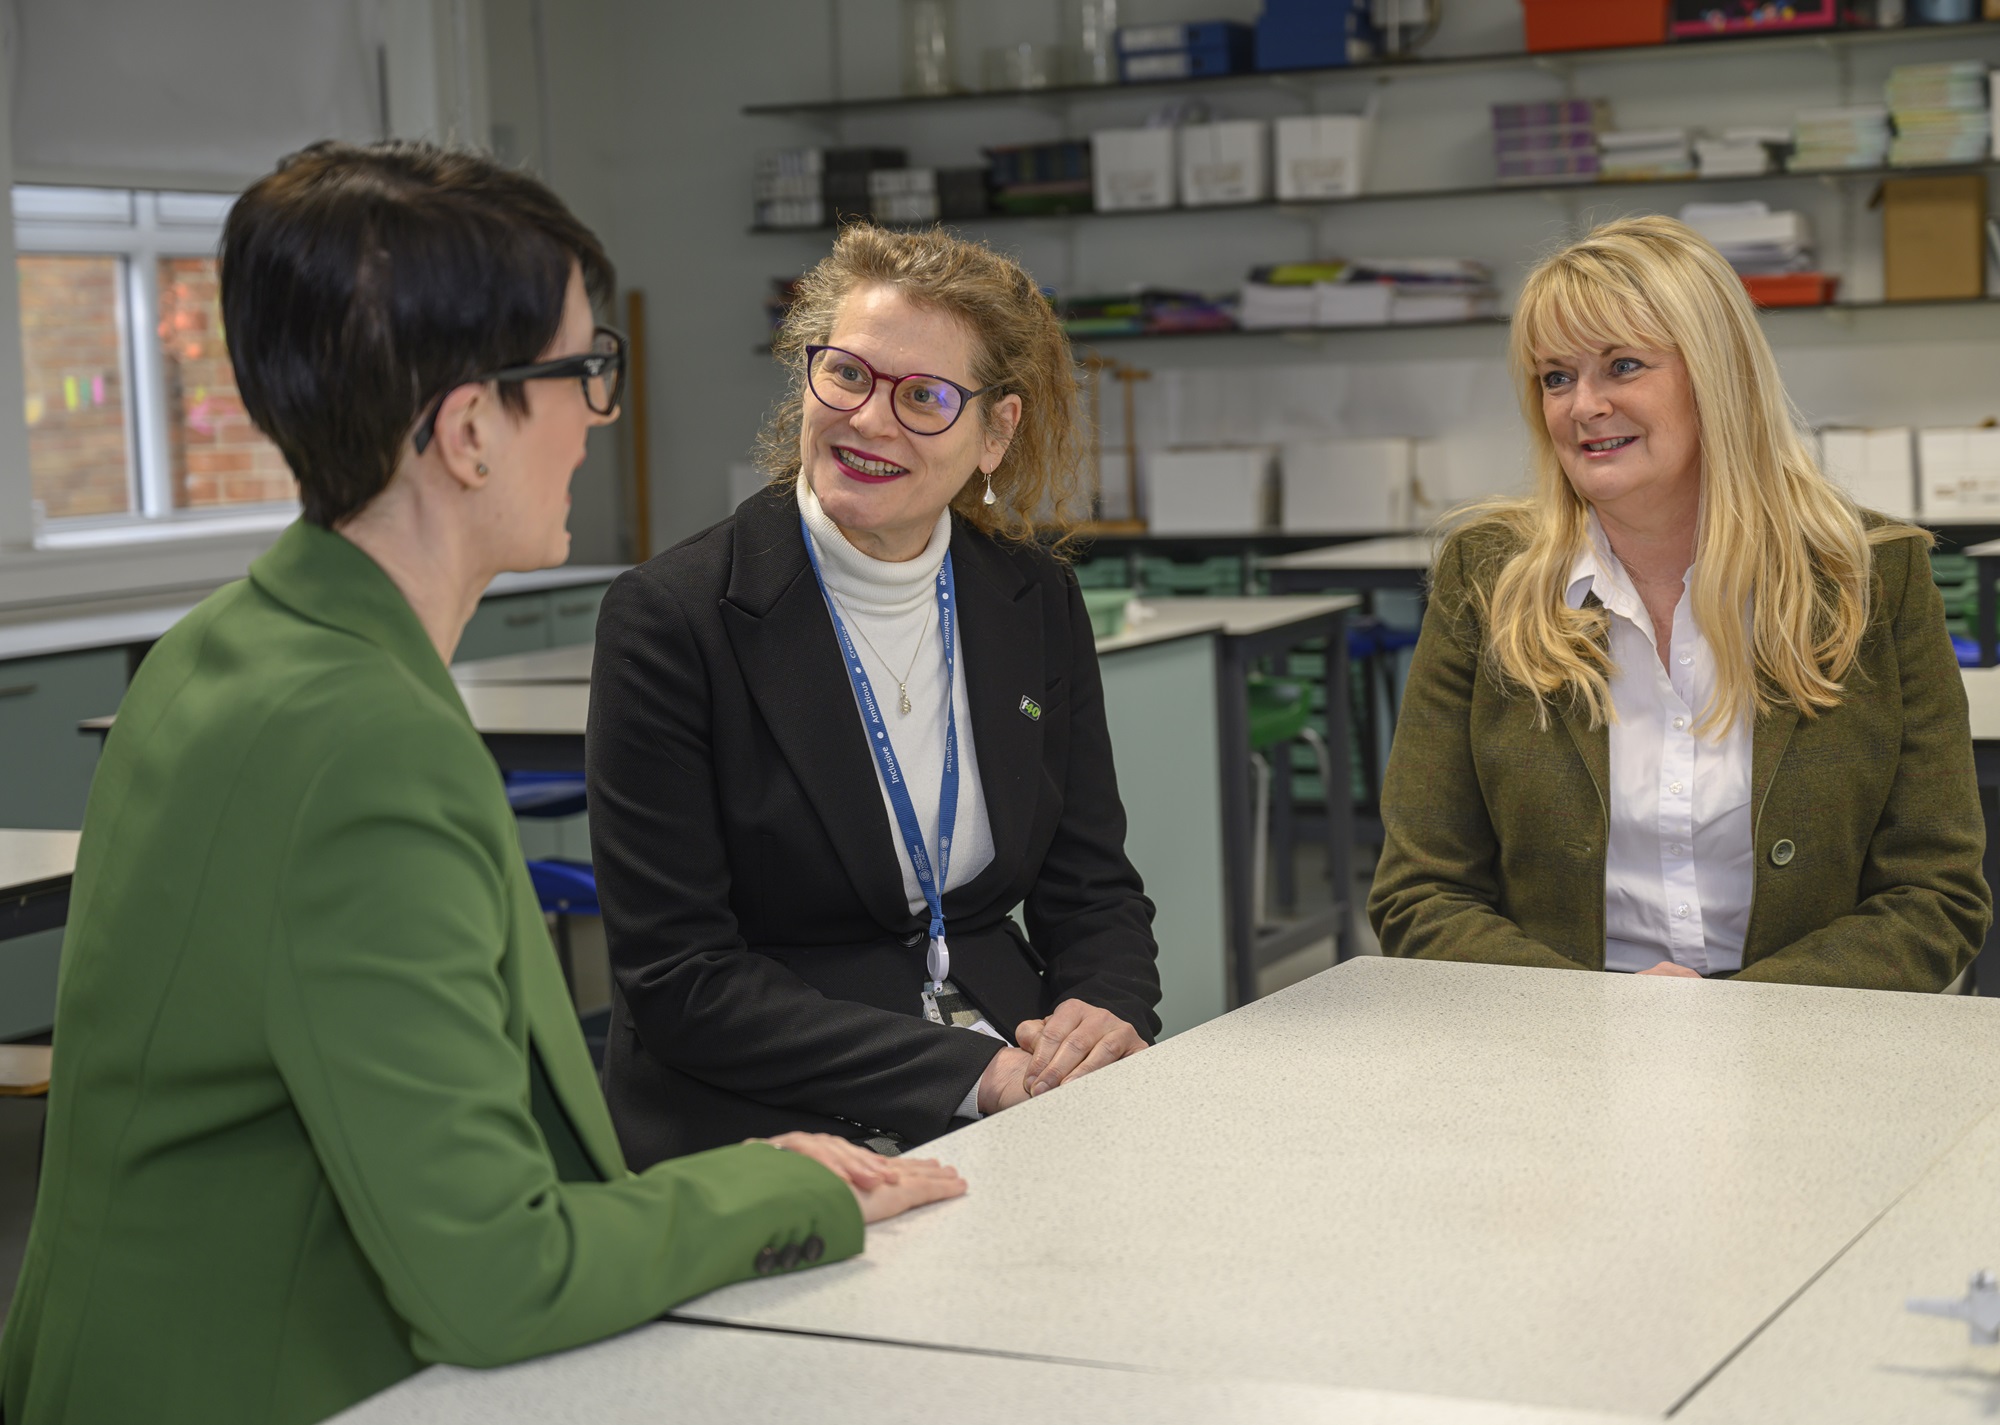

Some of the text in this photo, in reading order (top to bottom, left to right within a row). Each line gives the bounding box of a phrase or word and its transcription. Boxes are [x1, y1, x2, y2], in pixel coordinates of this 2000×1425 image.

[943, 607, 951, 649] Ambitious
[841, 625, 900, 784] Inclusive Ambitious Creative
[1021, 699, 1040, 718] f40
